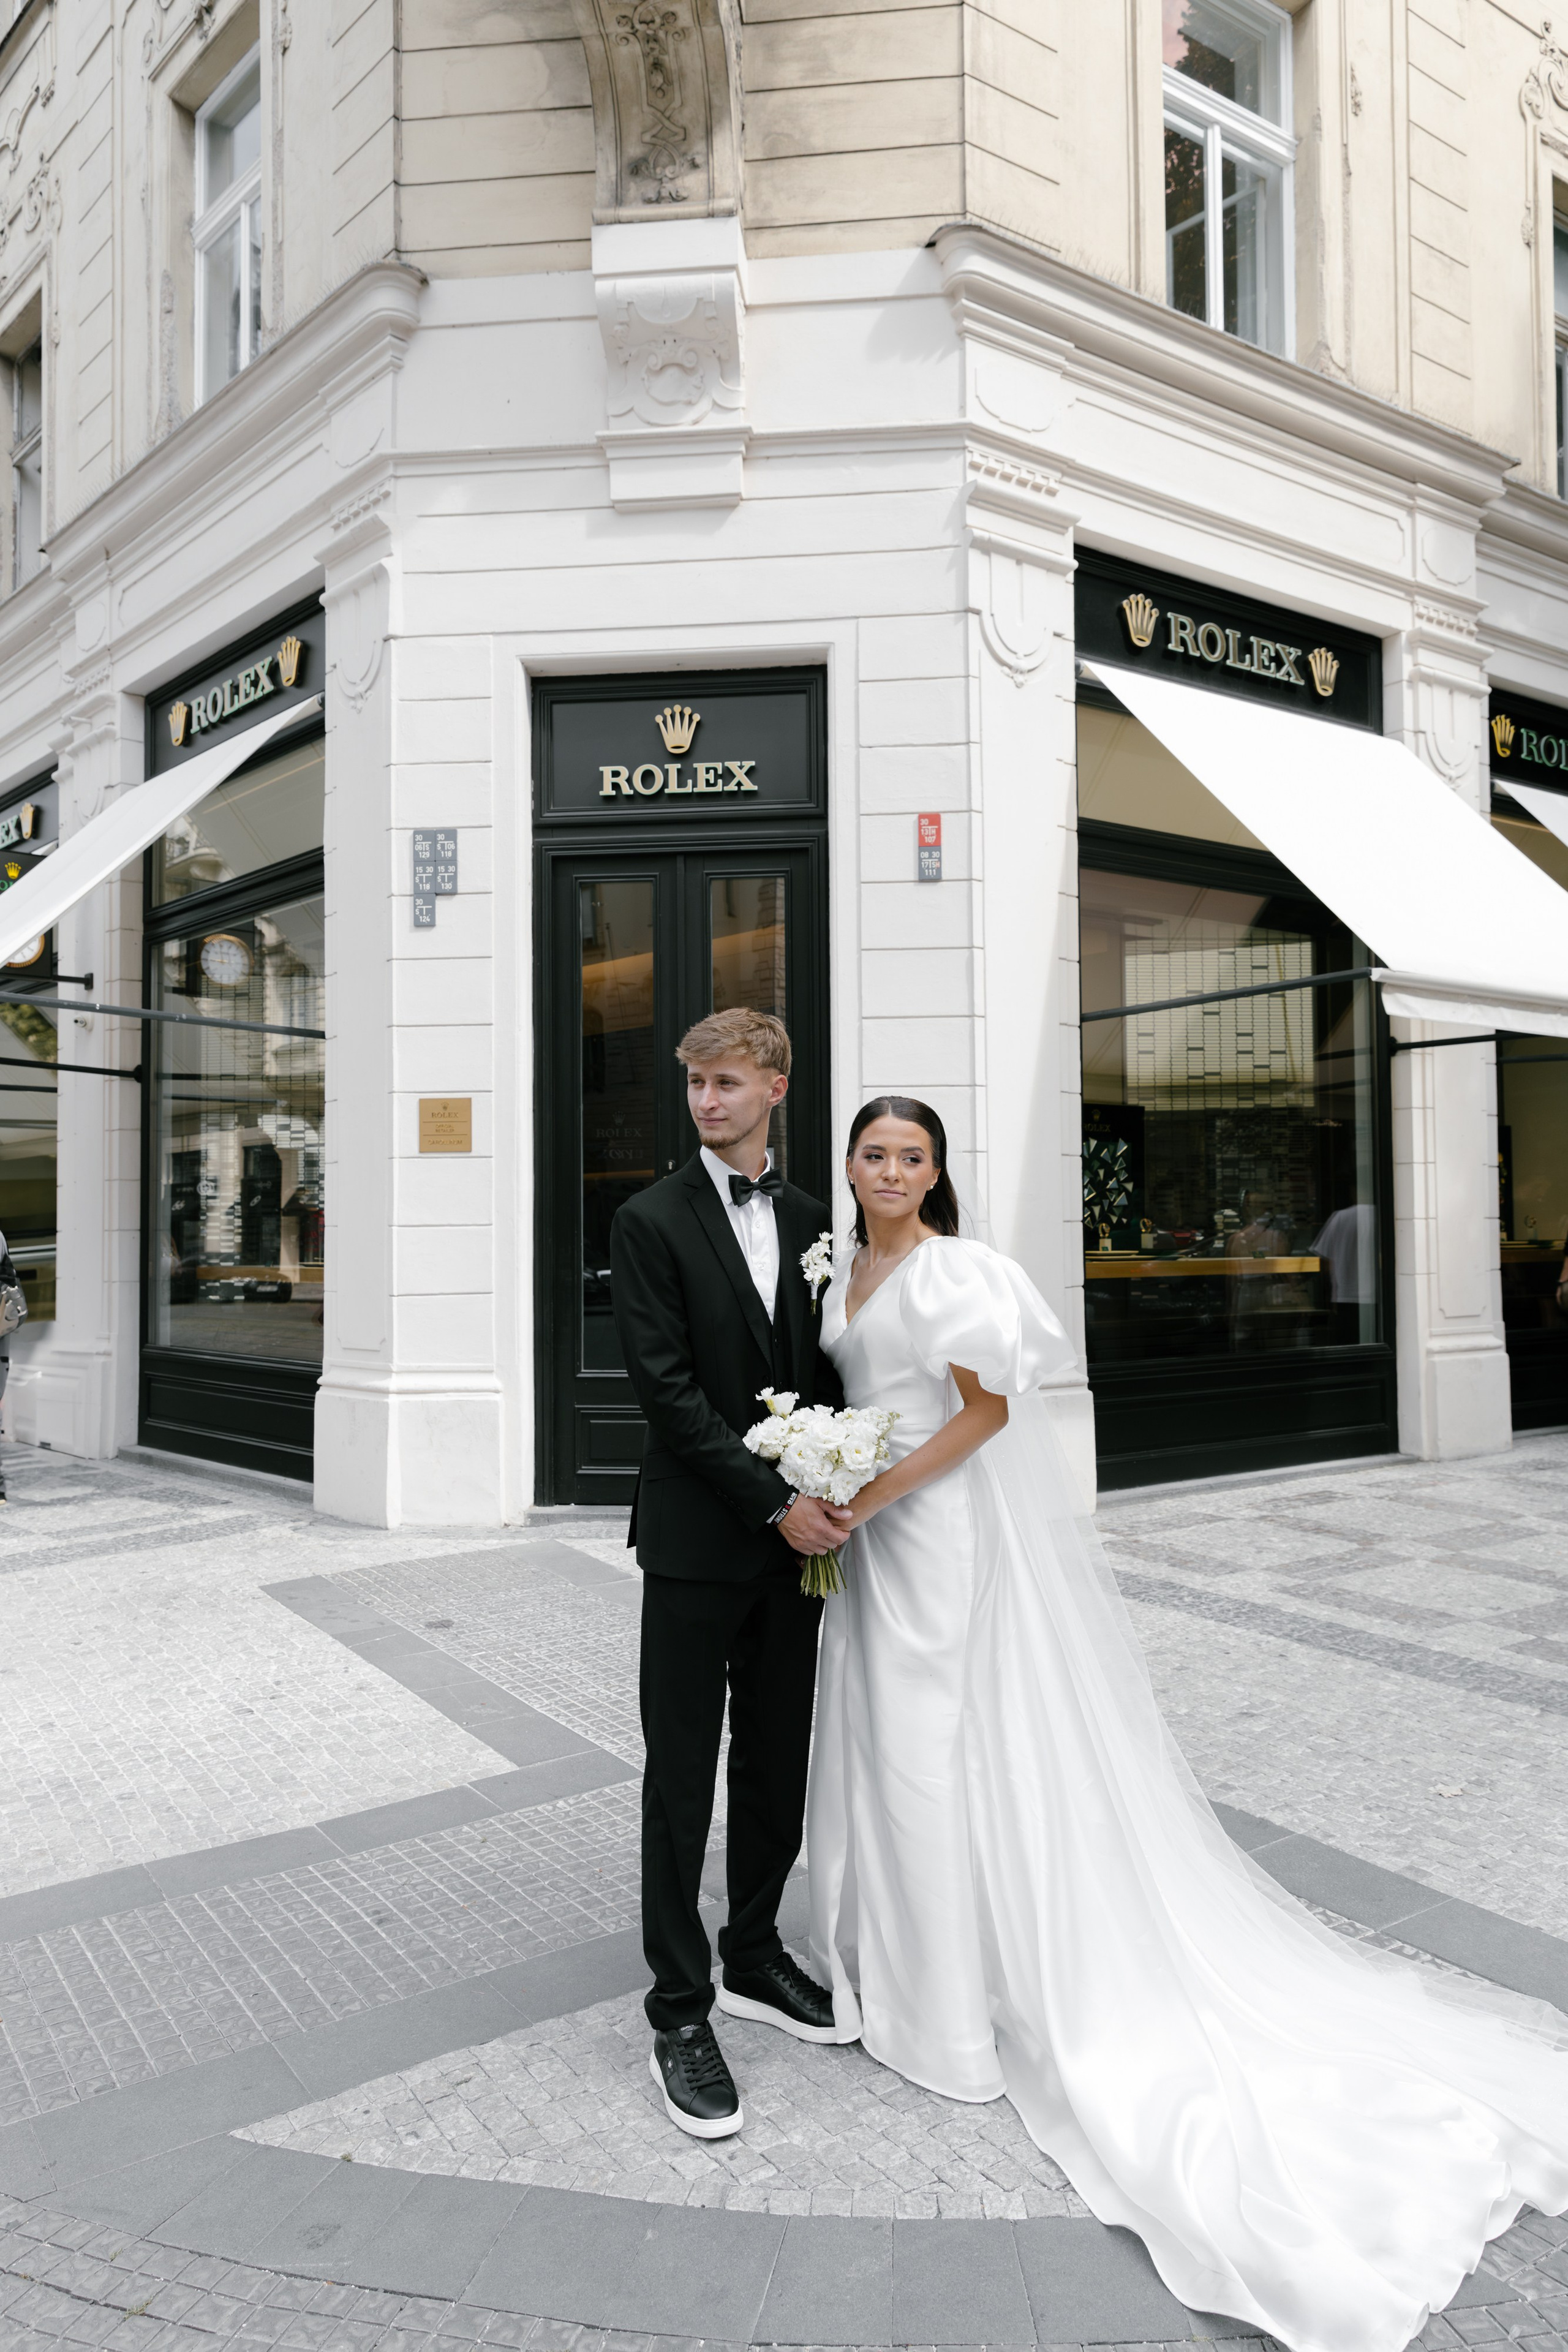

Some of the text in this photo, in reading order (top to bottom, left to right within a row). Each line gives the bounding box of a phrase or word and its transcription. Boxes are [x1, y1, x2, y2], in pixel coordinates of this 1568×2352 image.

[1167, 612, 1305, 685] ROLEX
[190, 656, 274, 734] ROLEX
[599, 761, 758, 796] ROLEX
